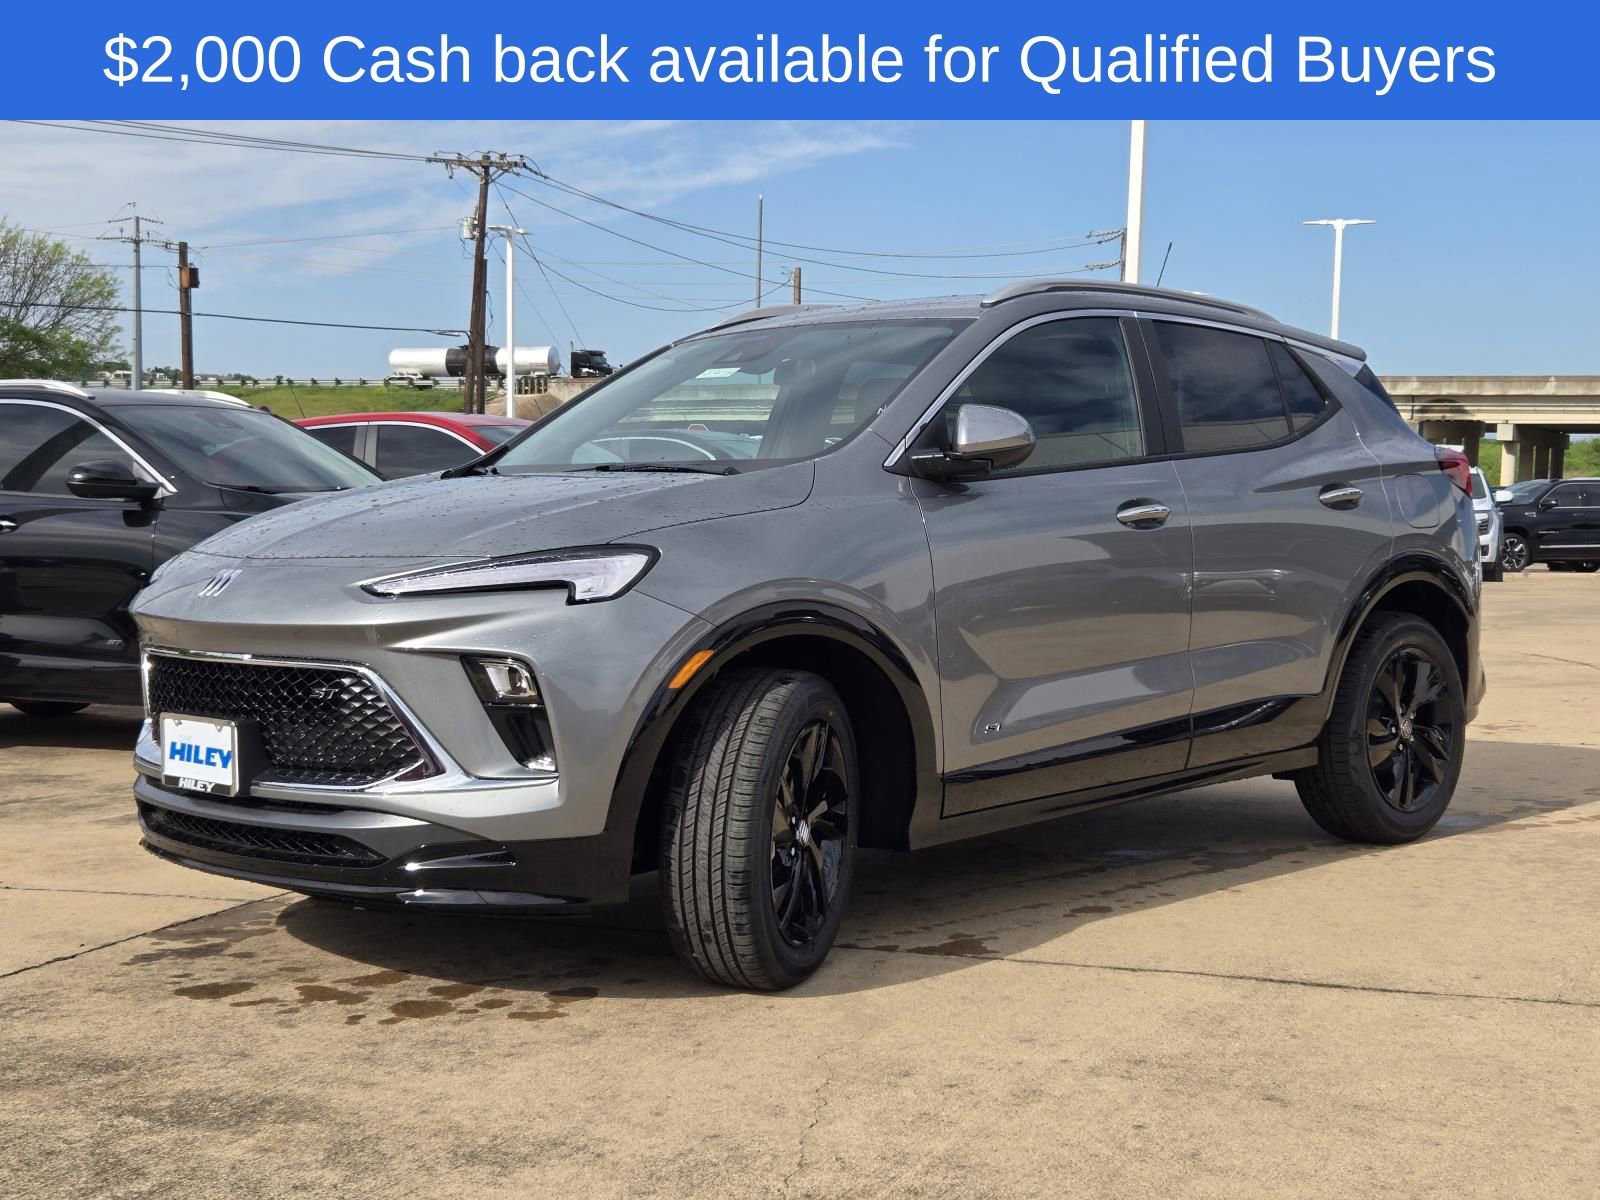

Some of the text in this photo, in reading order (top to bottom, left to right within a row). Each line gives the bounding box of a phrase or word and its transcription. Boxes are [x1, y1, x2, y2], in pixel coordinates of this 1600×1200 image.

[309, 687, 339, 699] ST
[169, 741, 233, 769] HILEY
[178, 777, 216, 793] HILEY
